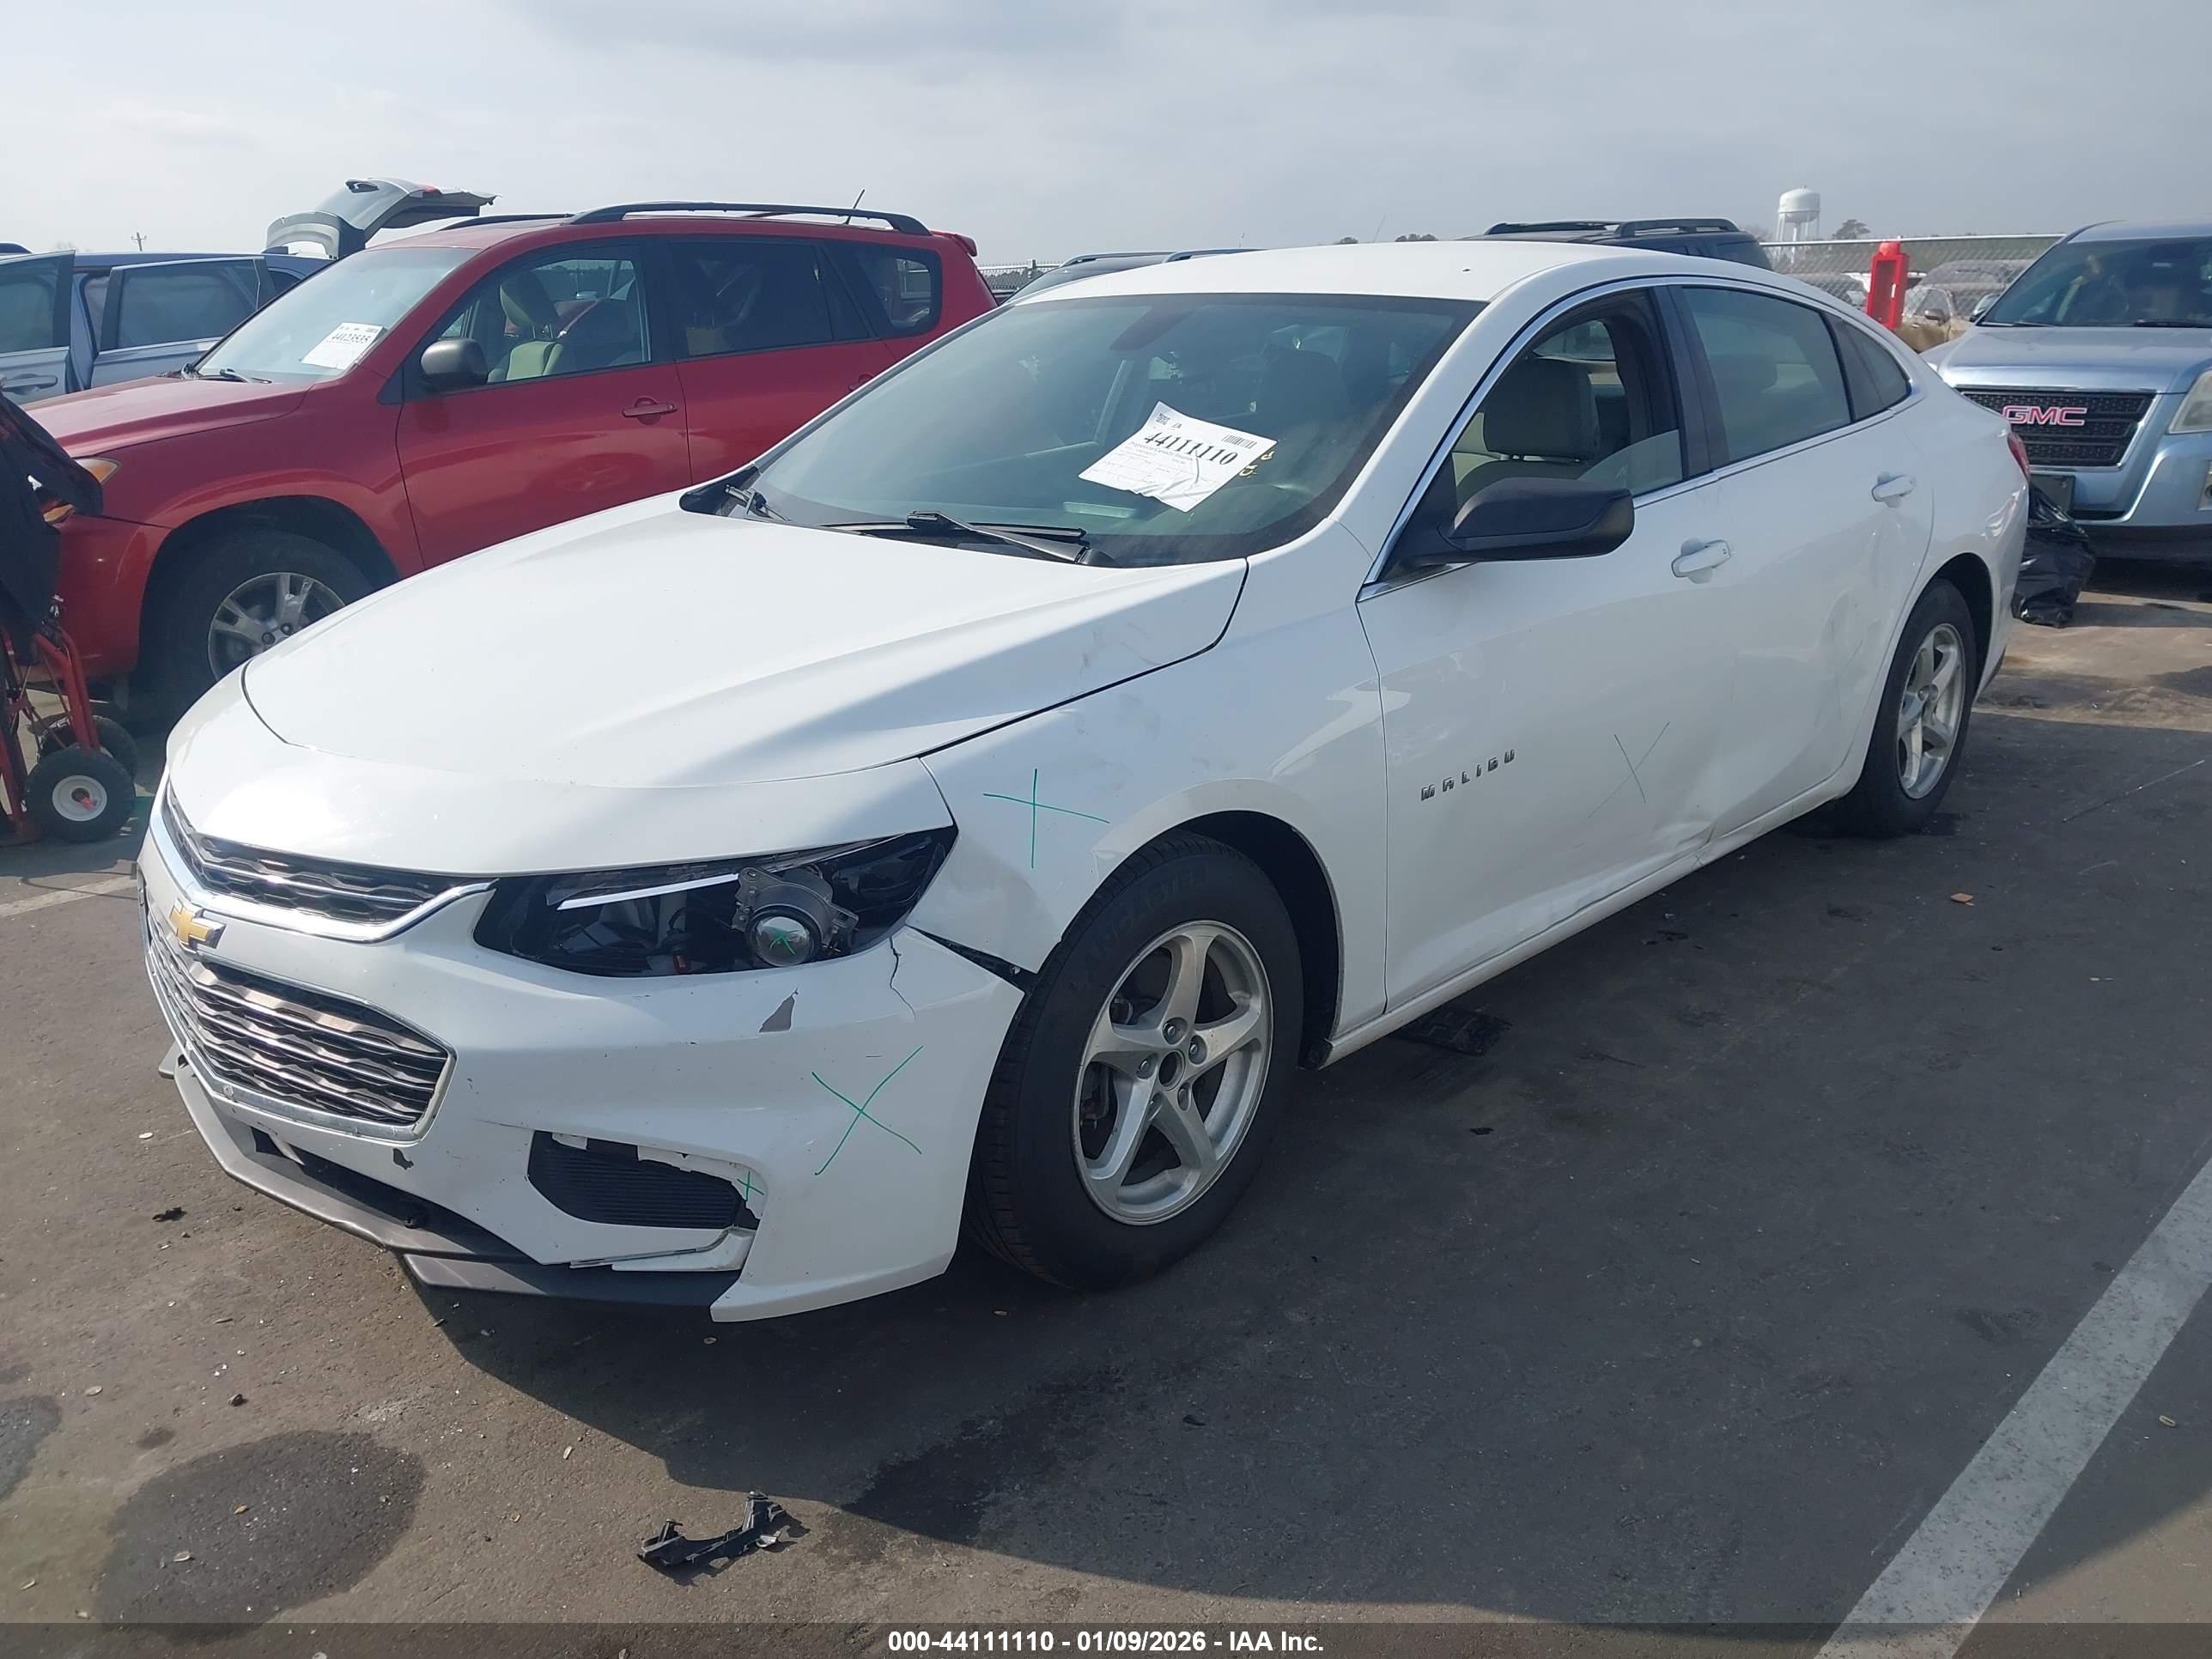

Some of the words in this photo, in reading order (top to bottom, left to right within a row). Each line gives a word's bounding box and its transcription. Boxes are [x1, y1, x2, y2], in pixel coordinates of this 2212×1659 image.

[2002, 405, 2087, 426] GMC
[1144, 431, 1238, 465] 44111110
[1420, 749, 1515, 800] MALIBU
